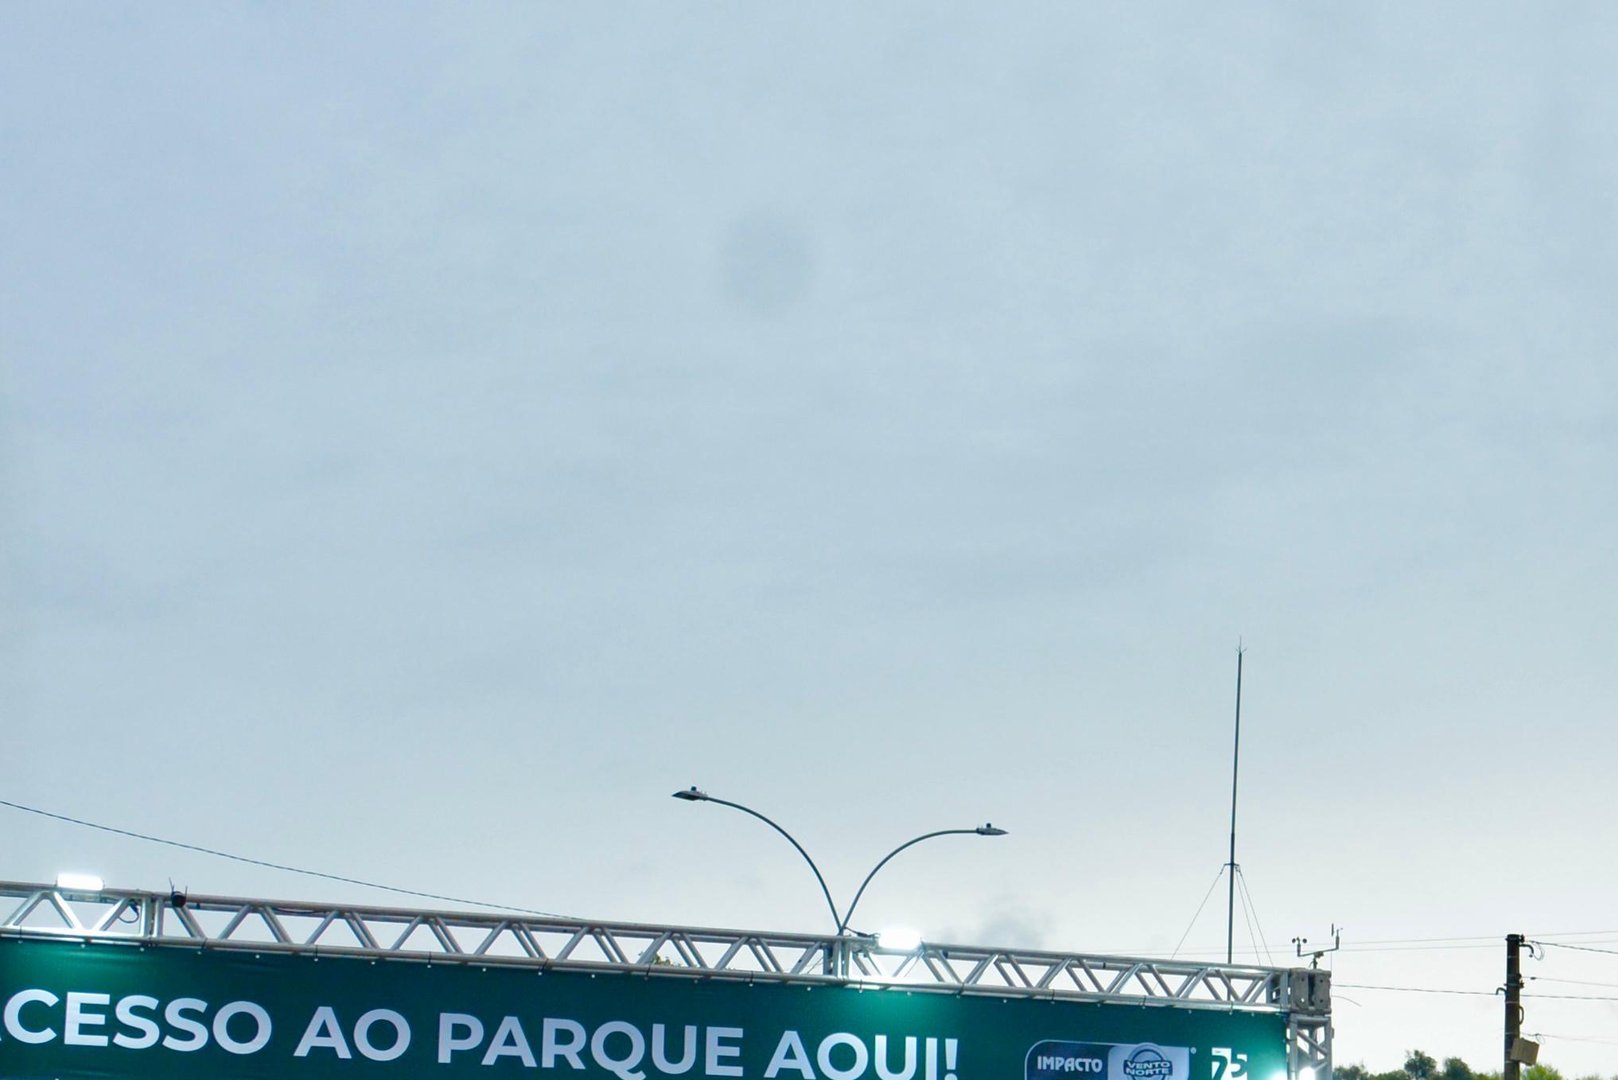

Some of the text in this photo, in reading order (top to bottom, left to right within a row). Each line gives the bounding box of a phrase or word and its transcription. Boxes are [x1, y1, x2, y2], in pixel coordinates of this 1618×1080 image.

[0, 988, 272, 1055] CESSO
[293, 1006, 411, 1061] AO
[1037, 1055, 1103, 1073] IMPACTO
[1126, 1060, 1171, 1069] VENTO
[1125, 1068, 1170, 1077] NORTE
